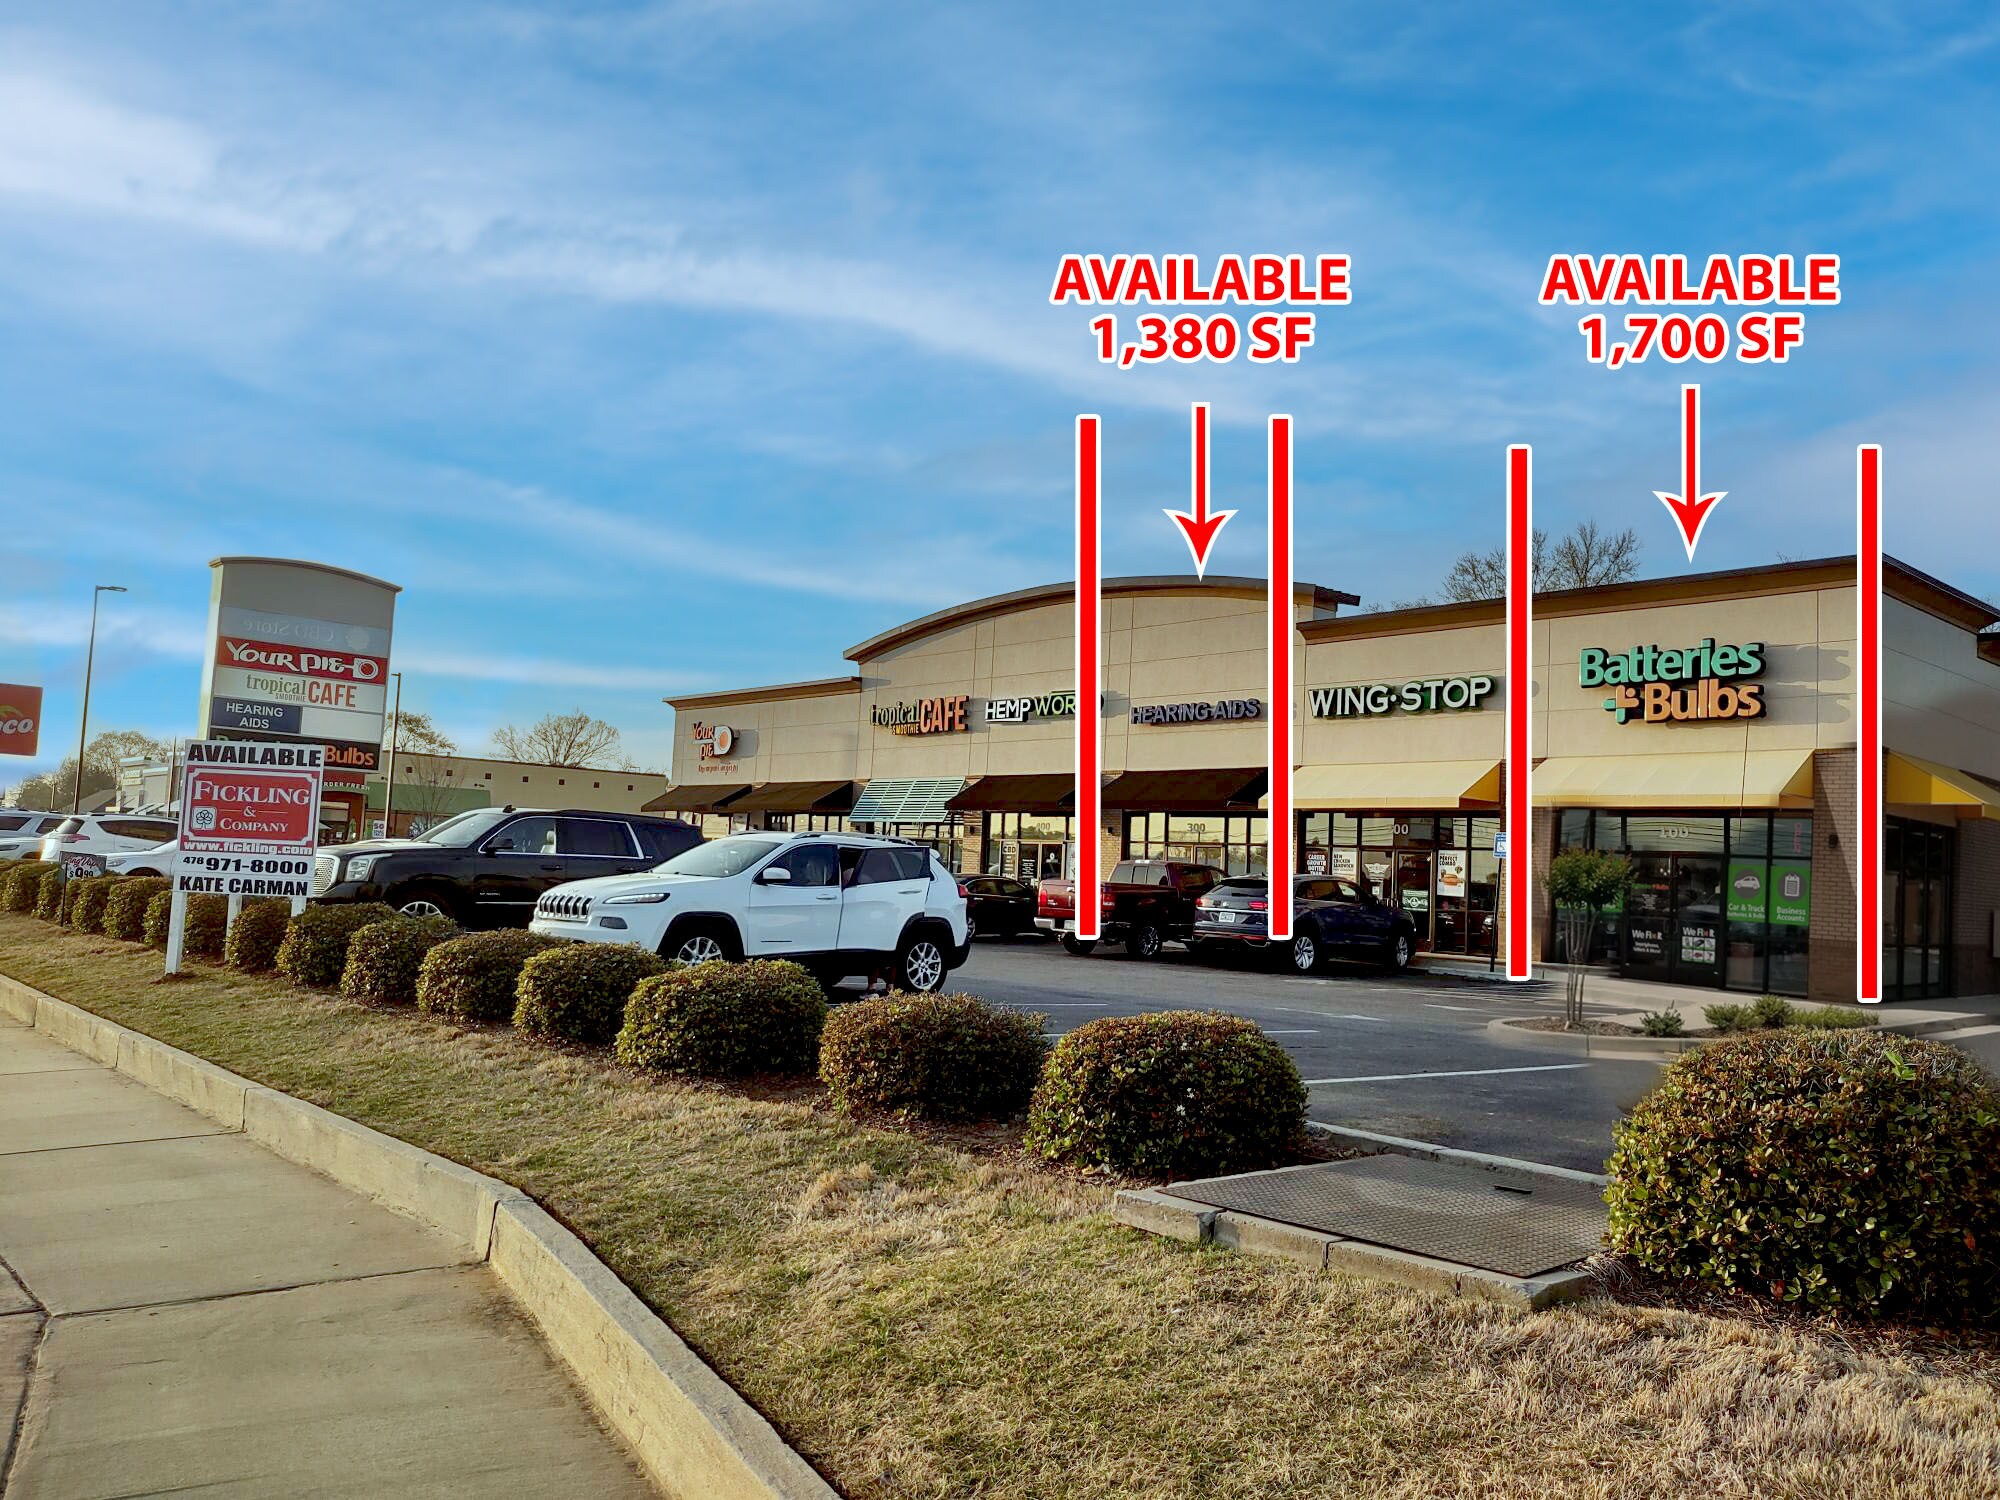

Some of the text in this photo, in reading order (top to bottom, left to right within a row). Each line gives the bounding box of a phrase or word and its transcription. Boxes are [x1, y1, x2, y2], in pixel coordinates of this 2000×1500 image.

[1579, 637, 1765, 689] Batteries
[246, 674, 358, 708] tropical CAFE
[1643, 680, 1766, 723] Bulbs
[226, 702, 284, 718] HEARING
[870, 695, 970, 734] tropical CAFE
[983, 693, 1104, 721] HEMP WOR
[1130, 698, 1261, 725] HEARING AIDS
[239, 717, 270, 729] AIDS
[187, 743, 323, 768] AVAILABLE
[324, 744, 376, 768] Bulbs
[243, 805, 257, 818] &
[1186, 822, 1206, 833] 300
[183, 840, 314, 857] www.fickling.com
[183, 856, 309, 875] 478 971-8000
[179, 875, 309, 897] KATE CARMAN
[1682, 926, 1696, 936] We
